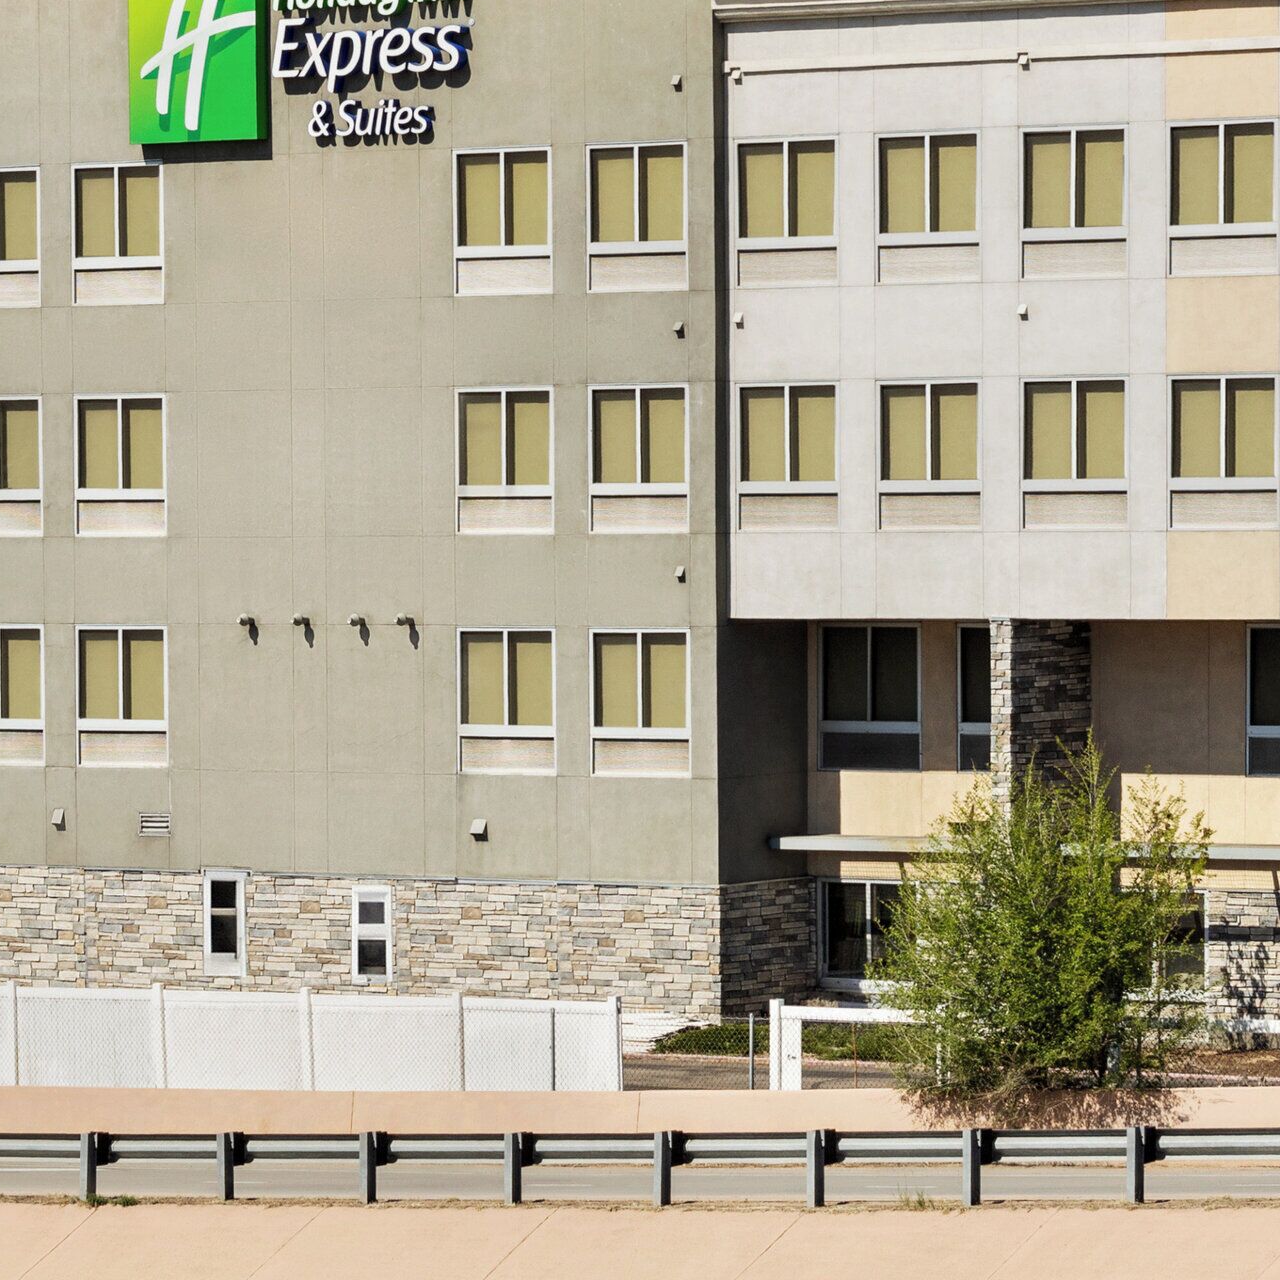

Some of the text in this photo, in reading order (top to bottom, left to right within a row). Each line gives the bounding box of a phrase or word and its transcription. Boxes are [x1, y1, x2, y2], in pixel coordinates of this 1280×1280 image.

[272, 18, 462, 93] Express
[308, 98, 429, 138] & Suites
